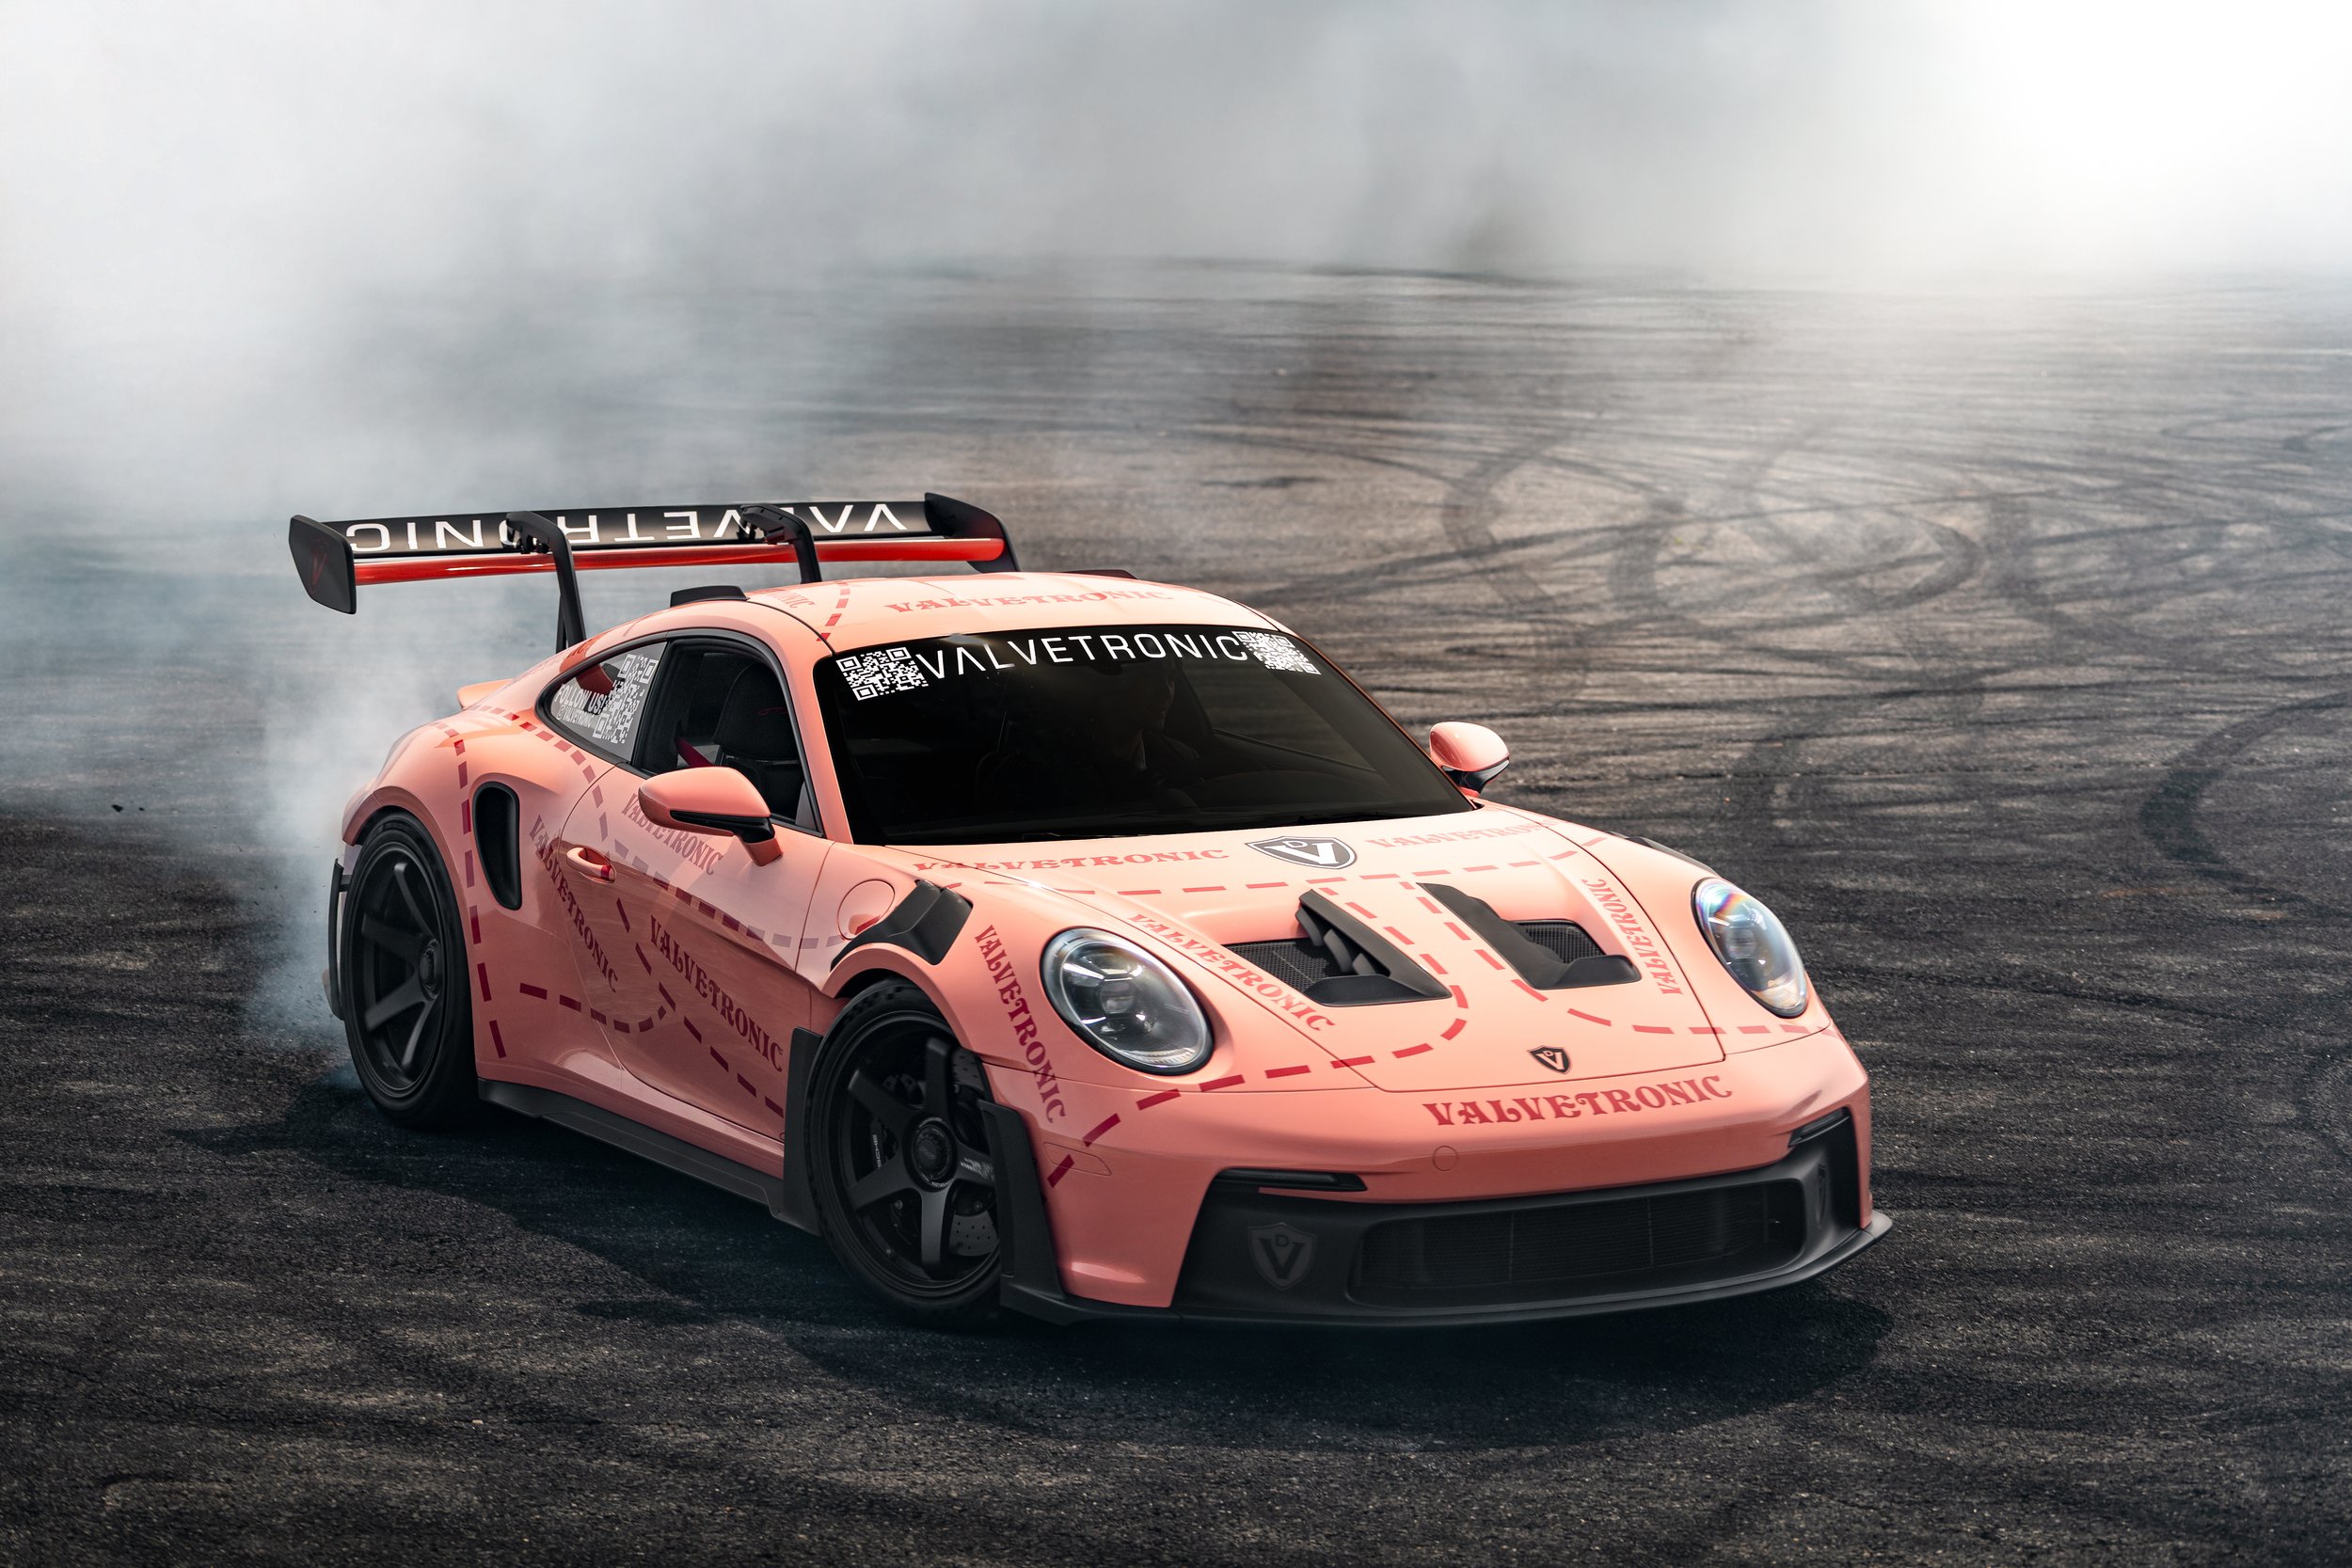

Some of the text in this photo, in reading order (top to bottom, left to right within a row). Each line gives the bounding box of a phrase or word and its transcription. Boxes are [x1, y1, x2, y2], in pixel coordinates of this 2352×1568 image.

[884, 591, 1174, 613] VALVETRONIC
[914, 633, 1249, 679] VALVETRONIC
[554, 684, 608, 714] FOLLOW US!
[913, 849, 1229, 871] VALVETRONIC
[529, 815, 618, 993] VALVETRONIC
[1581, 879, 1683, 995] VALVETRONIC
[650, 914, 784, 1072] VALVETRONIC
[1130, 914, 1336, 1032] VALVETRONIC
[974, 925, 1067, 1124] VALVETRONIC
[1422, 1075, 1733, 1126] VALVETRONIC
